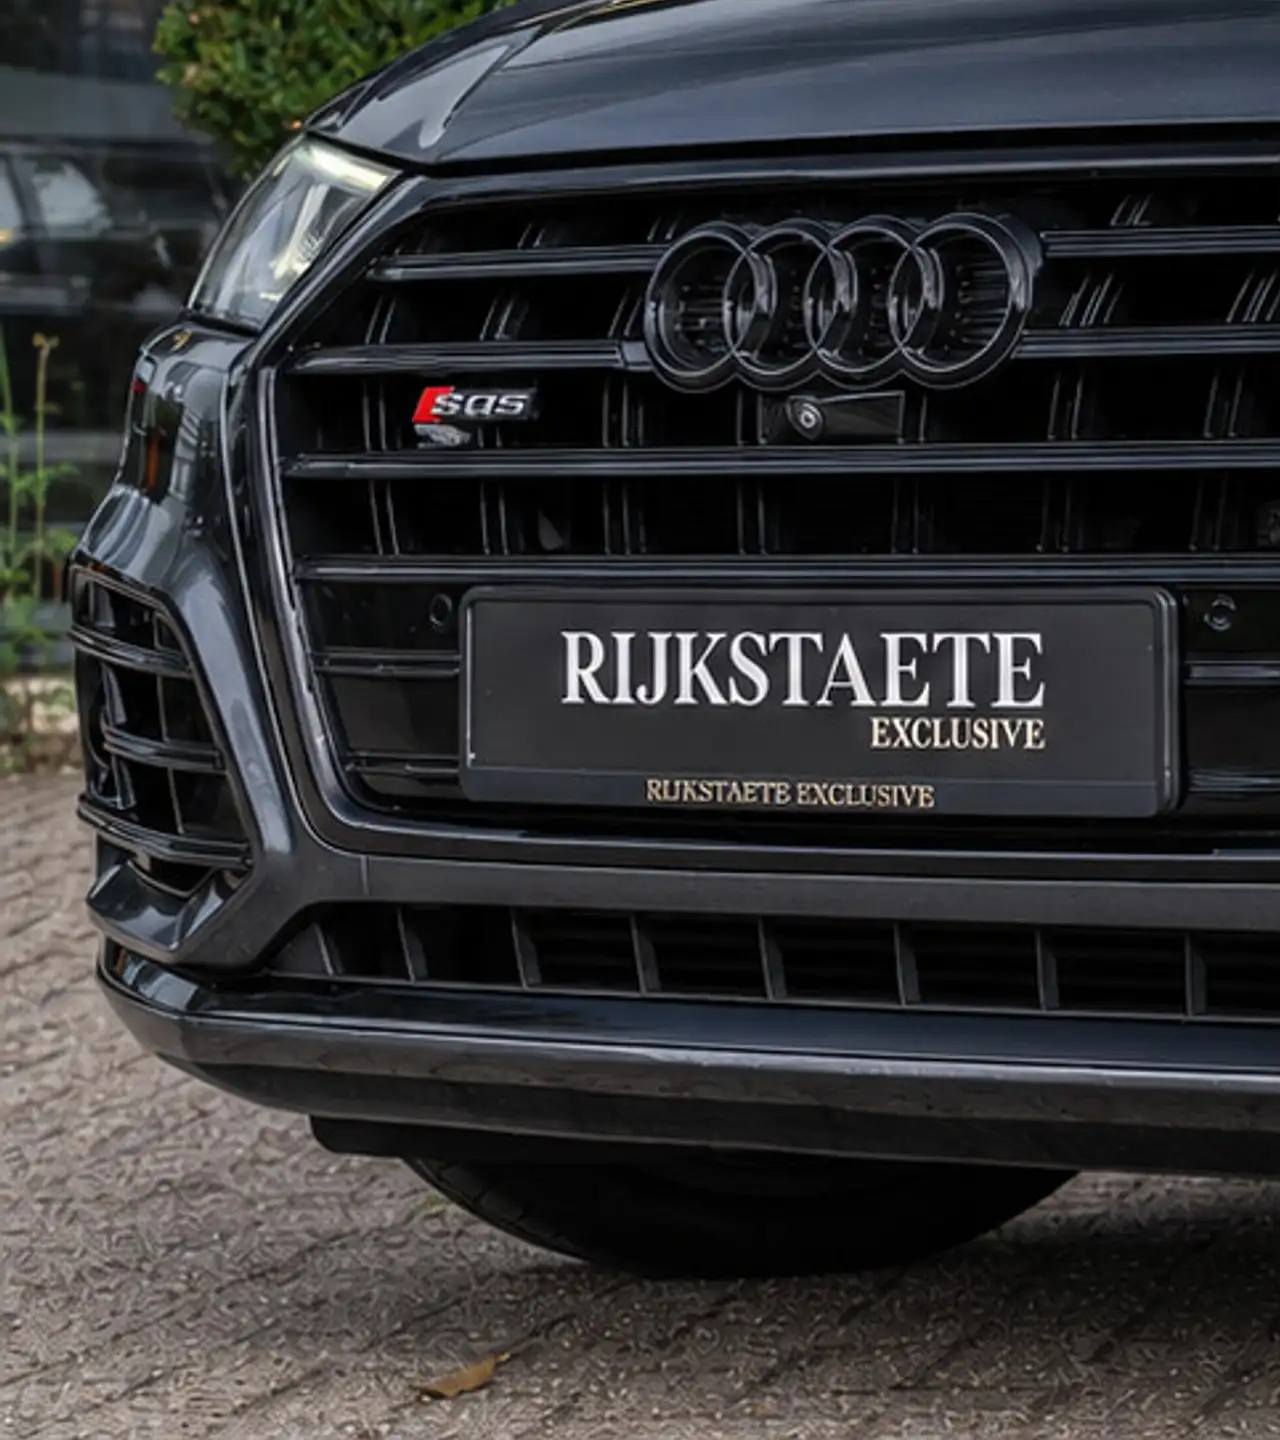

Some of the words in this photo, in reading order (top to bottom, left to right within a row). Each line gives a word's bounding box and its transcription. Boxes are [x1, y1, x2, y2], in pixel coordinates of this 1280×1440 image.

[561, 631, 1046, 708] RIJKSTAETE
[871, 717, 1046, 750] EXCLUSIVE
[646, 779, 792, 806] RIJKSTAETE
[796, 782, 935, 809] EXCLUSIVE
